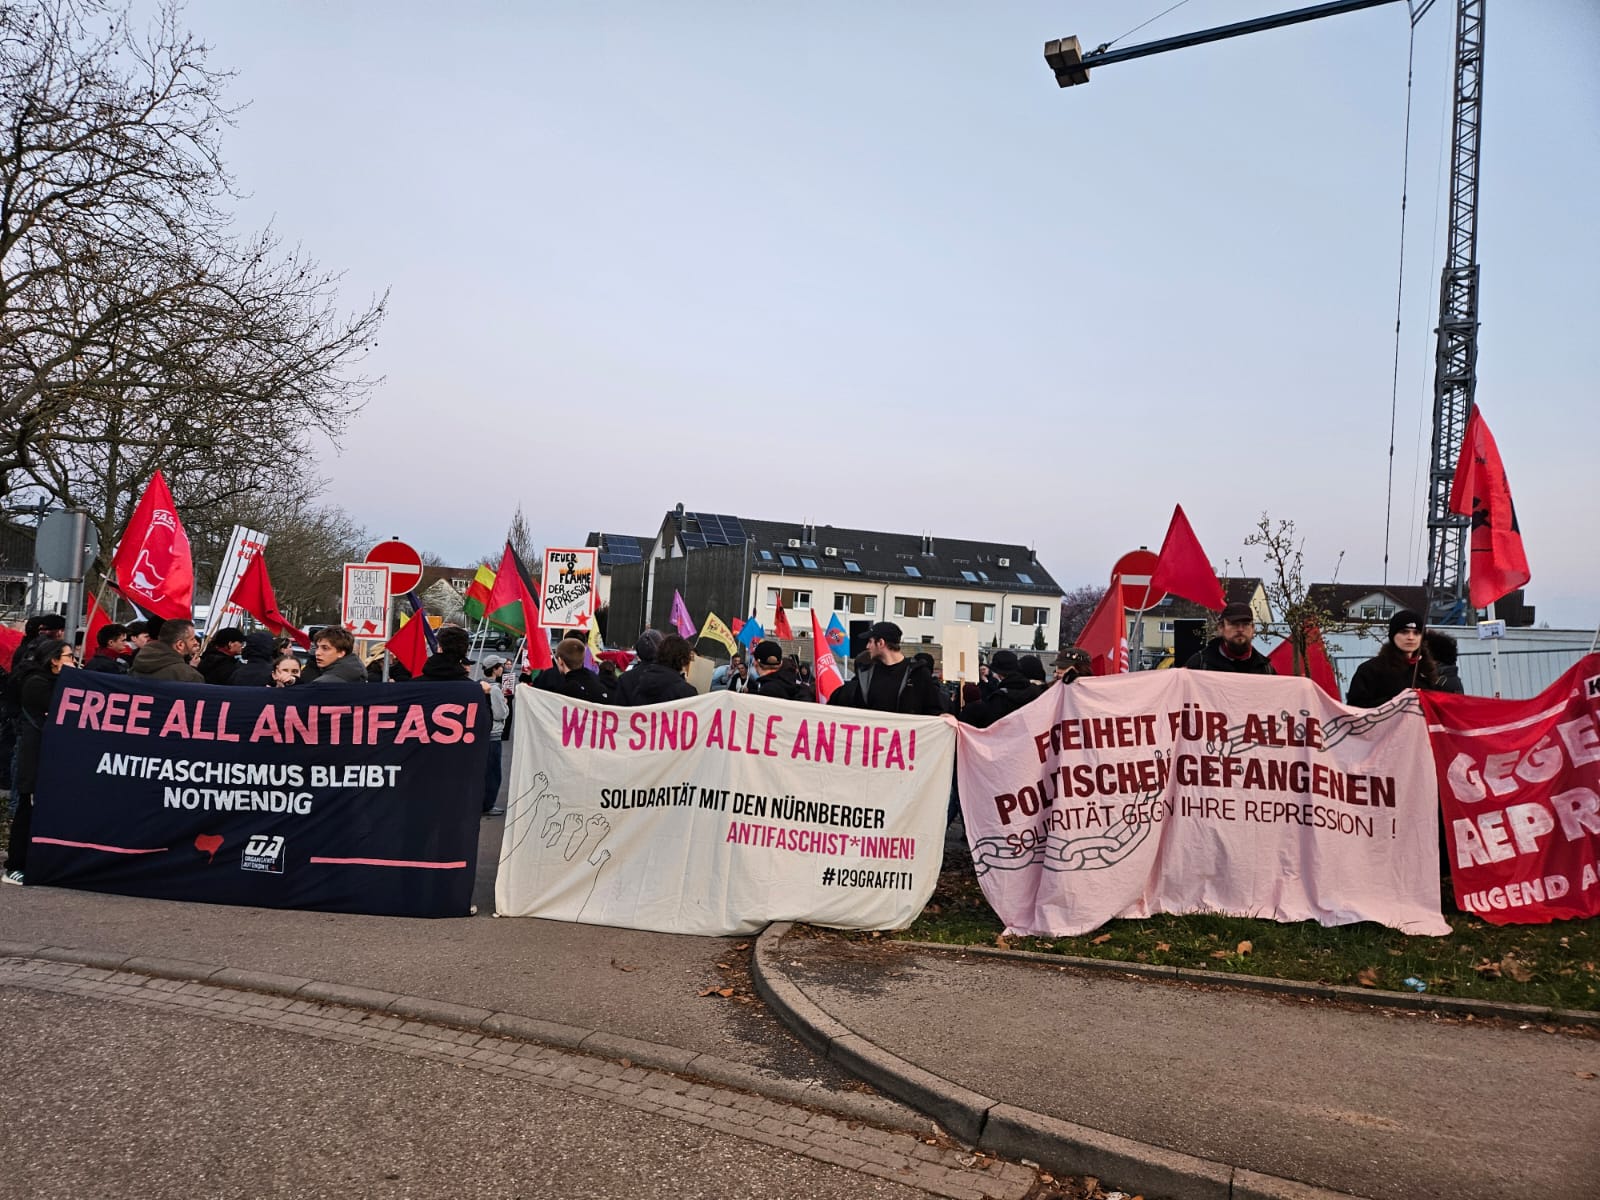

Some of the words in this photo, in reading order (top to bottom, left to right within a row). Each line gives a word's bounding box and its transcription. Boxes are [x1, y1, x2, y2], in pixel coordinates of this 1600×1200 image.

[550, 552, 577, 563] FEUER
[567, 562, 575, 574] &
[548, 584, 565, 594] DER
[559, 573, 591, 584] FLAMME
[545, 583, 592, 614] REPRESSION
[56, 687, 154, 736] FREE
[159, 700, 240, 743] ALL
[250, 702, 478, 744] ANTIFAS!
[1035, 714, 1157, 764] FREIHEIT
[1168, 703, 1229, 746] FÜR
[1242, 712, 1323, 749] ALLE
[561, 706, 619, 750] WIR
[629, 709, 698, 751] SIND
[706, 709, 783, 757] ALLE
[791, 718, 916, 772] ANTIFA!
[1447, 710, 1600, 804] GEGE
[96, 752, 305, 787] ANTIFASCHISMUS
[311, 764, 402, 788] BLEIBT
[1176, 754, 1396, 808] GEFANGENEN
[163, 786, 314, 815] NOTWENDIG
[600, 782, 697, 809] SOLIDARITÄT
[698, 788, 731, 812] MIT
[733, 792, 768, 818] DEN
[771, 795, 885, 829] NÜRNBERGER
[1182, 796, 1236, 820] IHRE
[1245, 800, 1374, 838] REPRESSION
[1391, 817, 1397, 840] !
[1582, 860, 1600, 891] A
